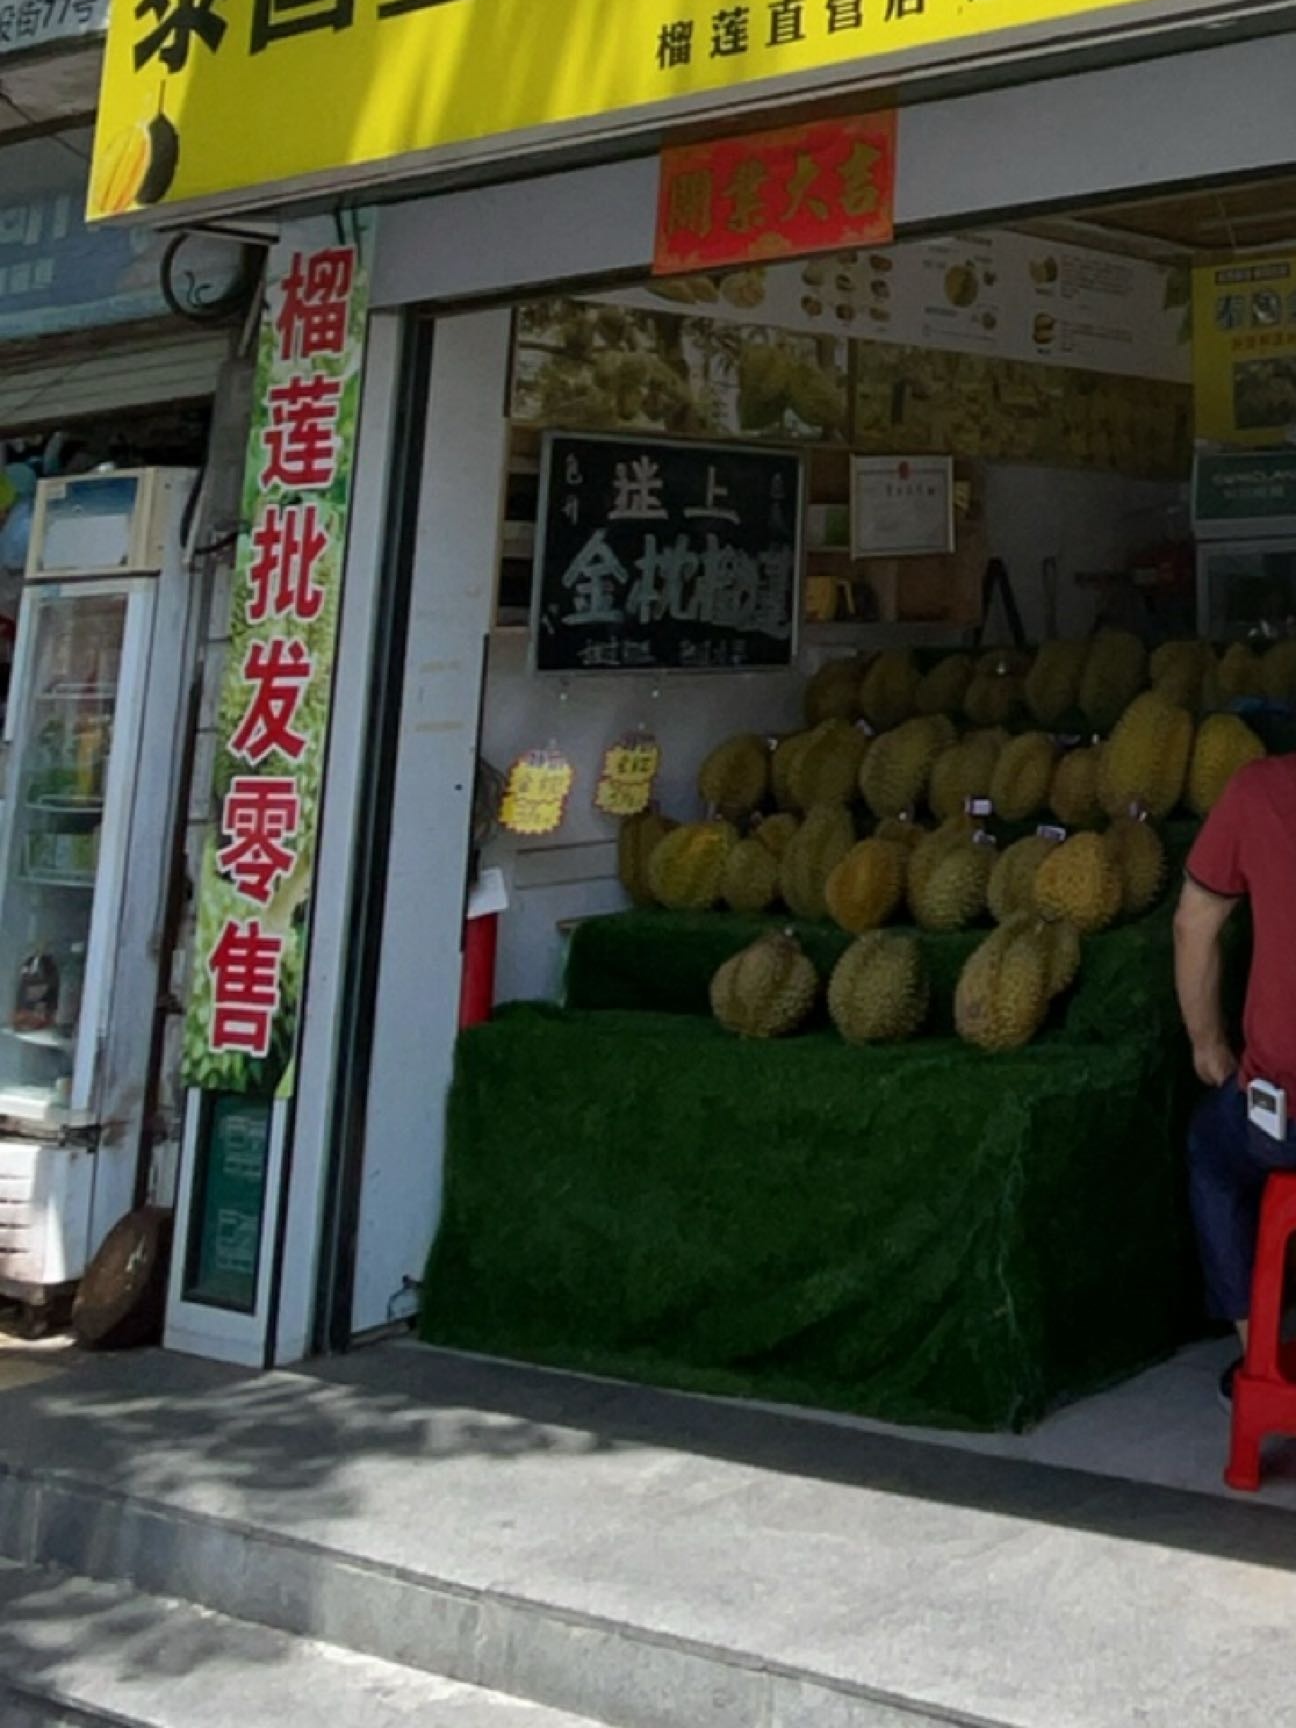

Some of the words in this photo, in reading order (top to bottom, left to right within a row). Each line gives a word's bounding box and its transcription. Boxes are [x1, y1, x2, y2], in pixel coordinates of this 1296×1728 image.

[667, 138, 882, 240] 開業大吉
[207, 245, 356, 1057] 榴莲批发零售
